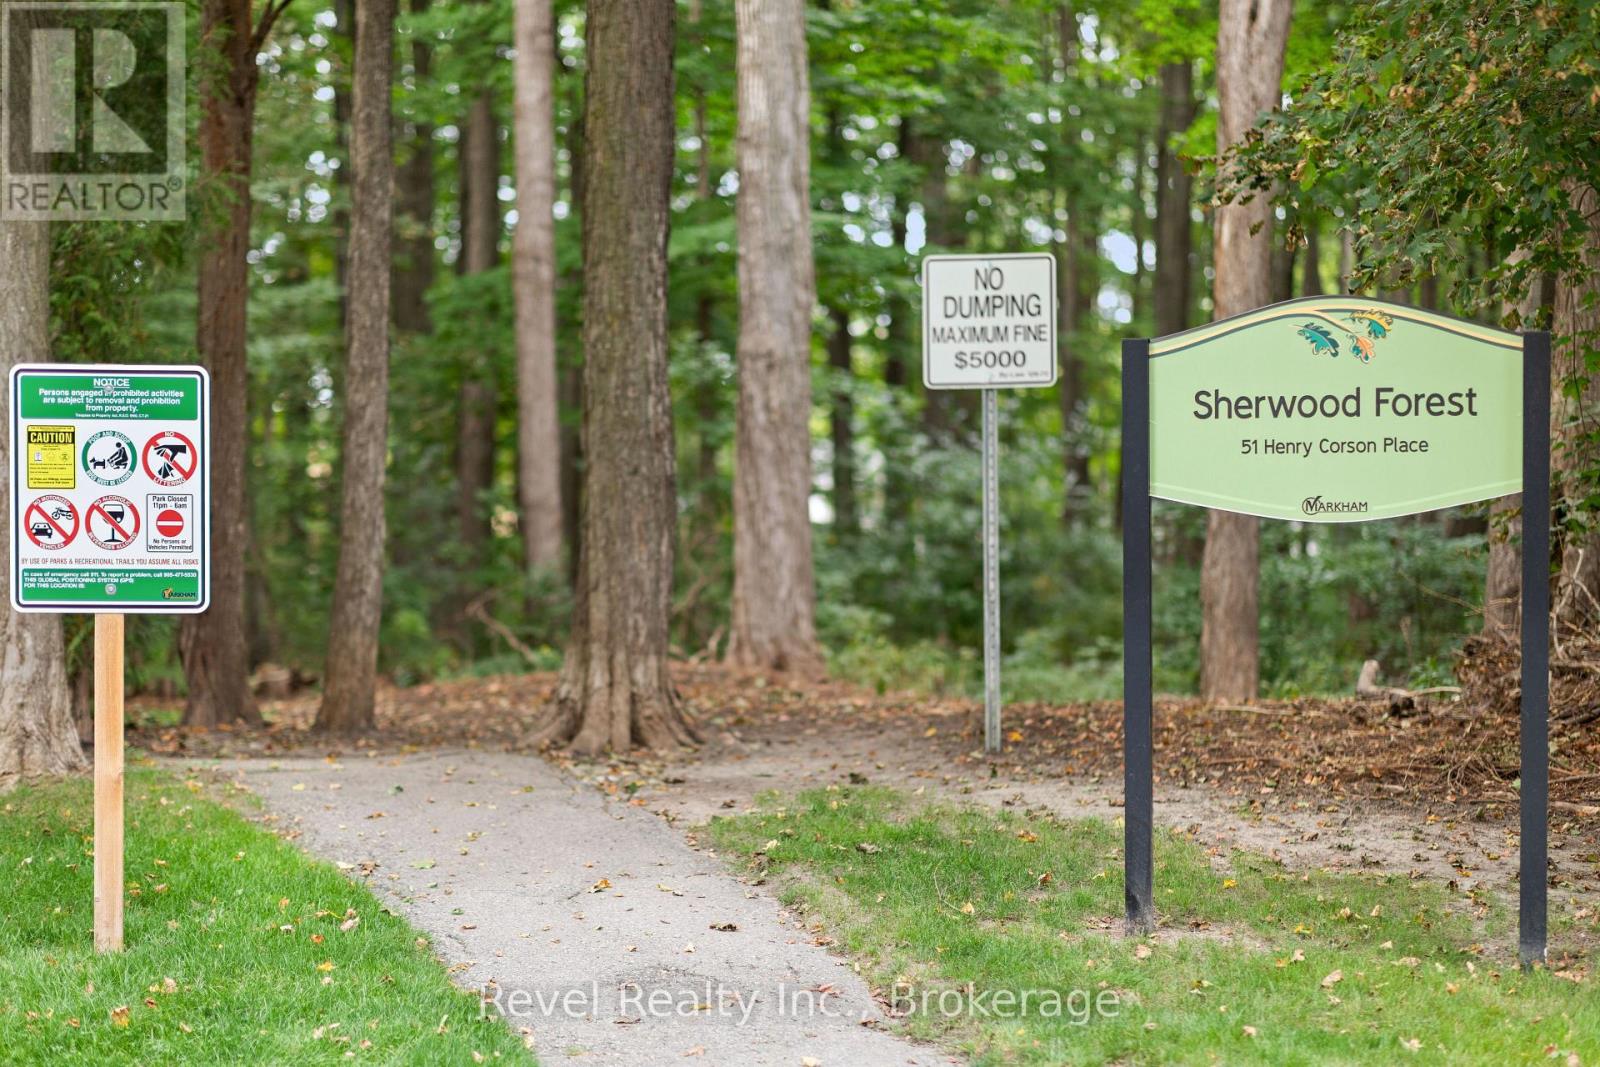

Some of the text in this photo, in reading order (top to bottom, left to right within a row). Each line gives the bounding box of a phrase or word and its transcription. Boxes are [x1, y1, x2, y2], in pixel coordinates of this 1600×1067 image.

[974, 268, 1004, 290] NO
[943, 294, 1042, 318] DUMPING
[932, 324, 1049, 344] MAXIMUM FINE
[954, 350, 1026, 370] $5000
[94, 378, 130, 387] NOTICE
[113, 389, 149, 398] prohibited
[142, 397, 180, 405] prohibition
[1193, 386, 1478, 419] Sherwood Forest
[30, 432, 72, 443] CAUTION
[1240, 437, 1429, 458] 51 Henry Corson Place
[1301, 495, 1368, 516] MARKHAM
